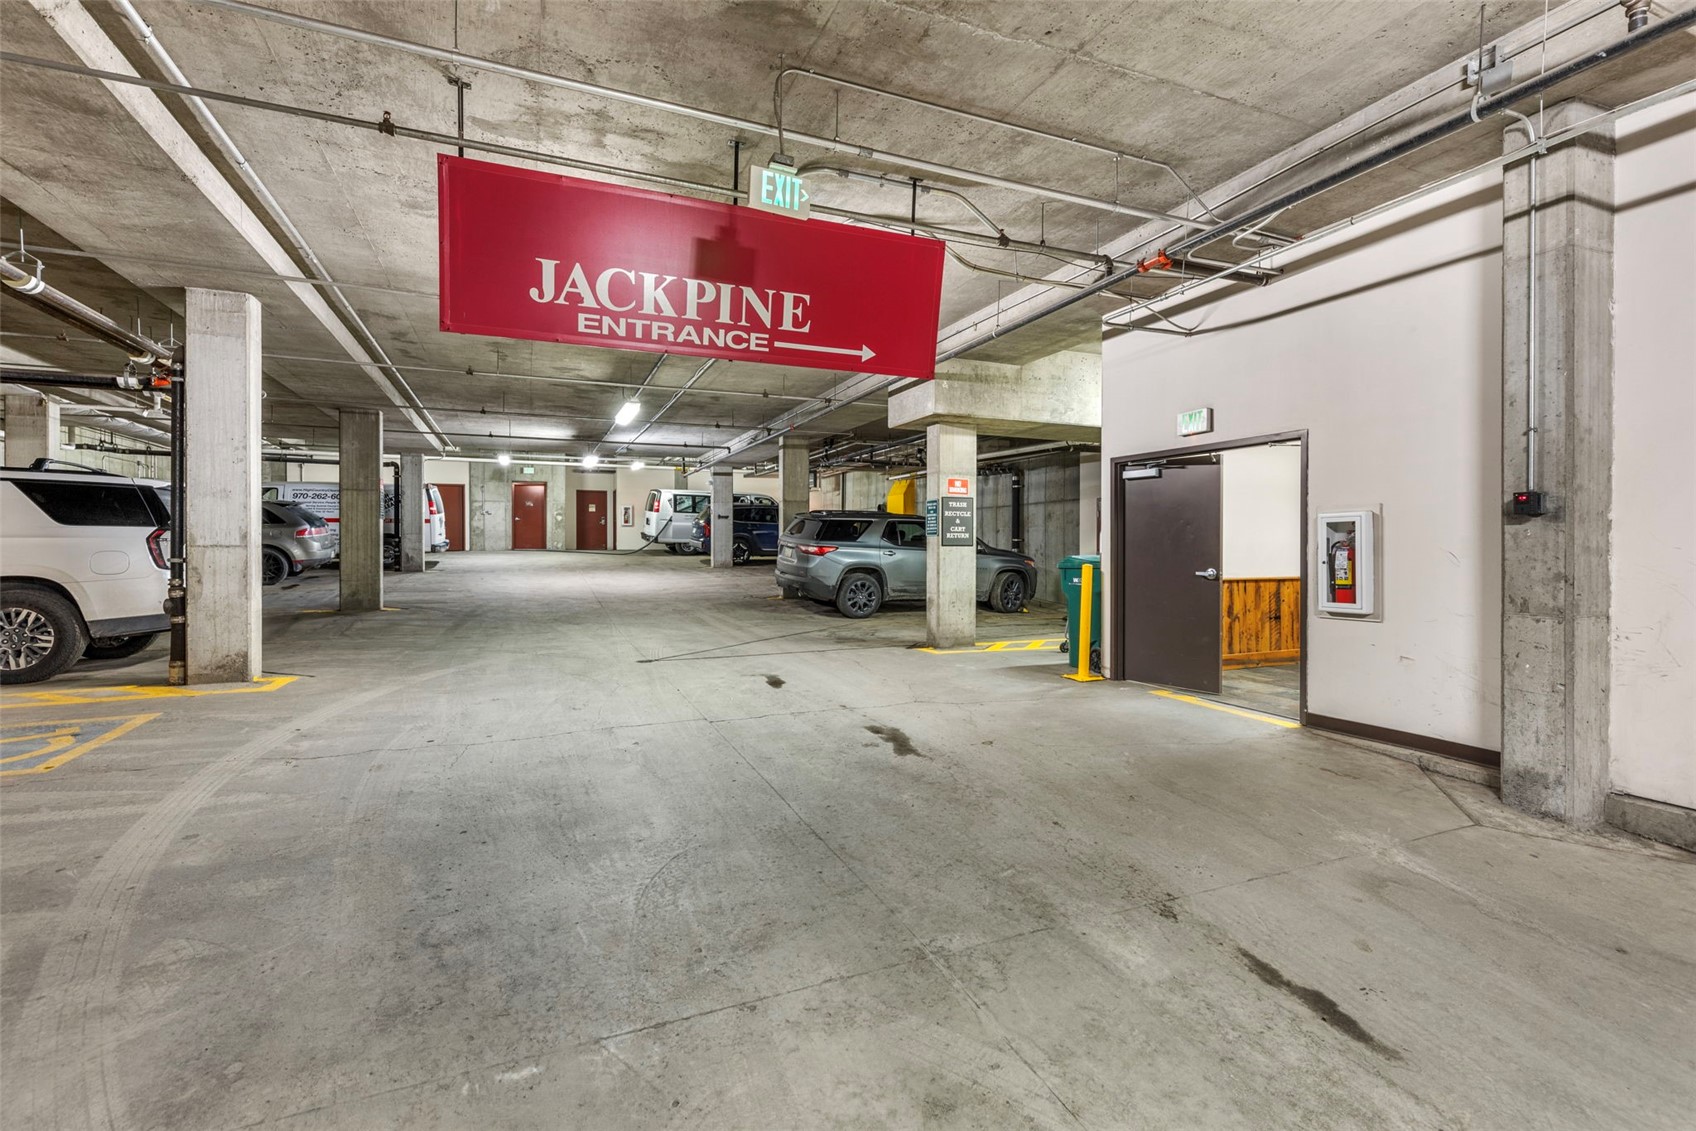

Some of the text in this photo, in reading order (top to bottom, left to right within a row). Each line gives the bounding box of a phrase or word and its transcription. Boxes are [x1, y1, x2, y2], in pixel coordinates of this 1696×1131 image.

[761, 170, 803, 211] EXIT
[529, 257, 811, 334] JACKPINE
[577, 312, 770, 353] ENTRANCE
